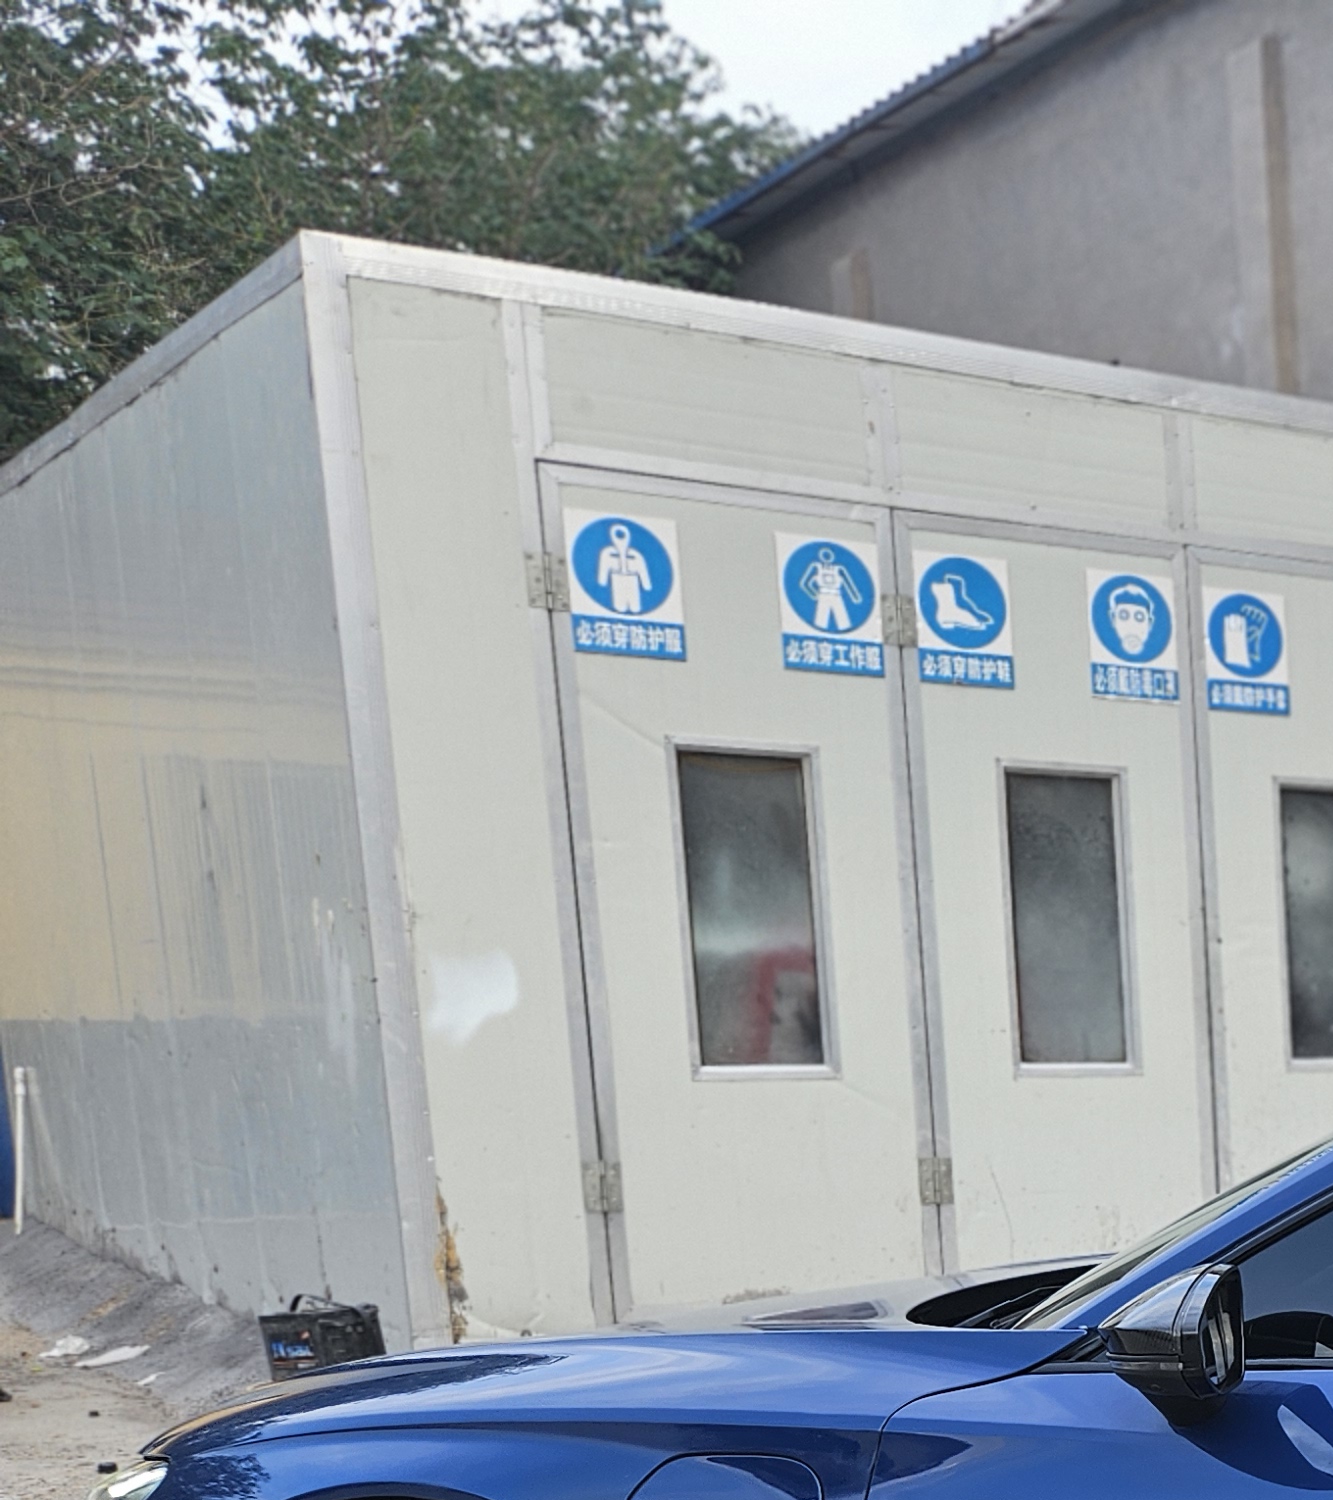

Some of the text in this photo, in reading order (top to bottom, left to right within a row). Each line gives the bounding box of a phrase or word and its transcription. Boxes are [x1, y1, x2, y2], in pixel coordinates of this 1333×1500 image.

[577, 620, 682, 652] 必须穿防护服
[785, 638, 882, 670] 必须穿工作服
[922, 653, 1012, 682] 必须穿防护鞋
